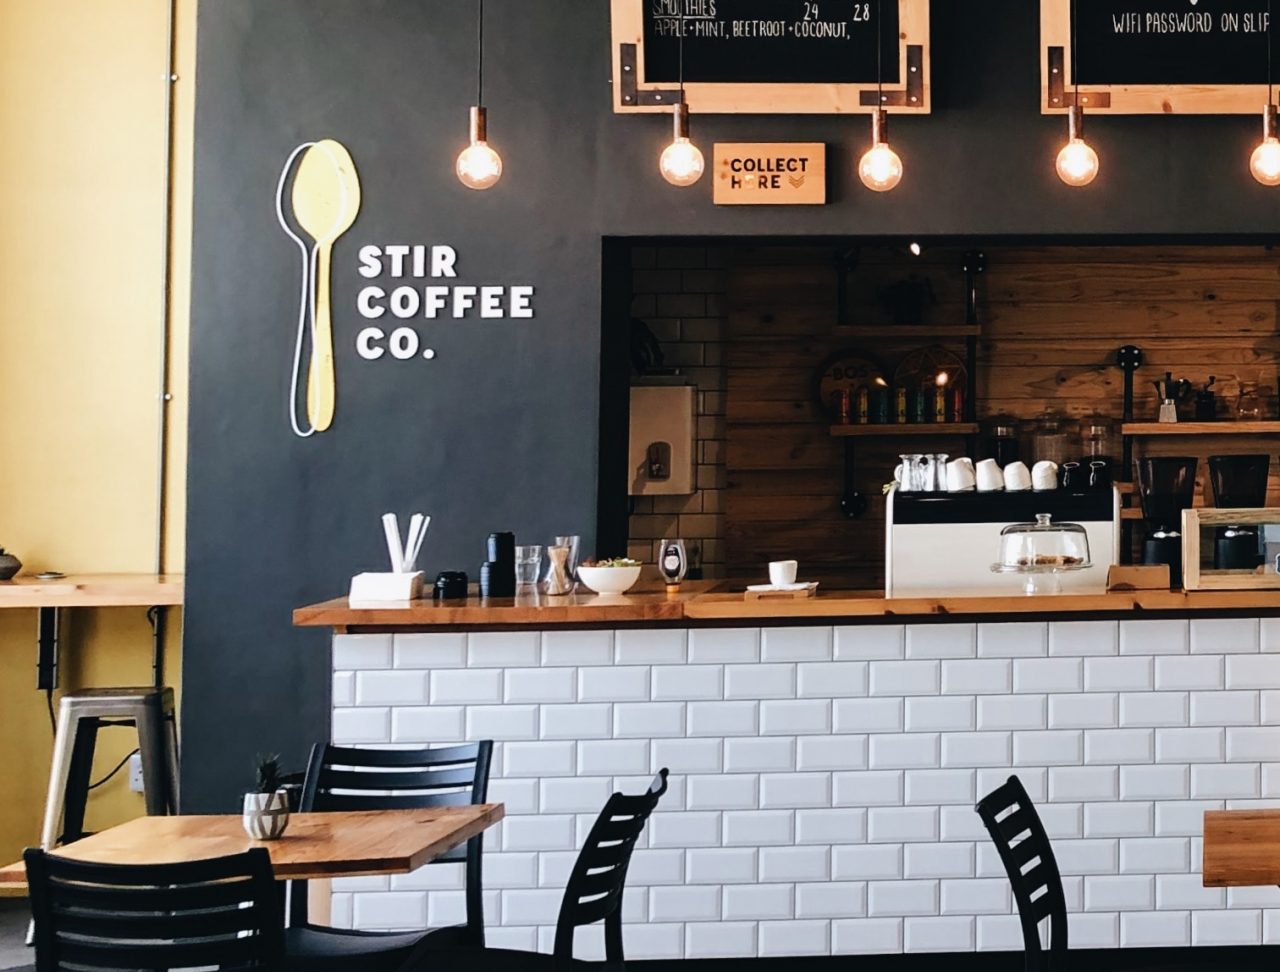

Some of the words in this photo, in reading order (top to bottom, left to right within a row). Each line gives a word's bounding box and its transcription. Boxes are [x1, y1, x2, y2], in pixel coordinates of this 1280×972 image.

[803, 2, 818, 21] 24
[853, 3, 870, 21] 28
[1112, 12, 1141, 33] WIFI
[1146, 12, 1212, 34] PASSWORD
[1221, 12, 1238, 33] ON
[730, 158, 809, 173] COLLECT
[357, 244, 458, 279] STIR
[355, 285, 535, 320] COFFEE
[355, 326, 436, 361] CO.
